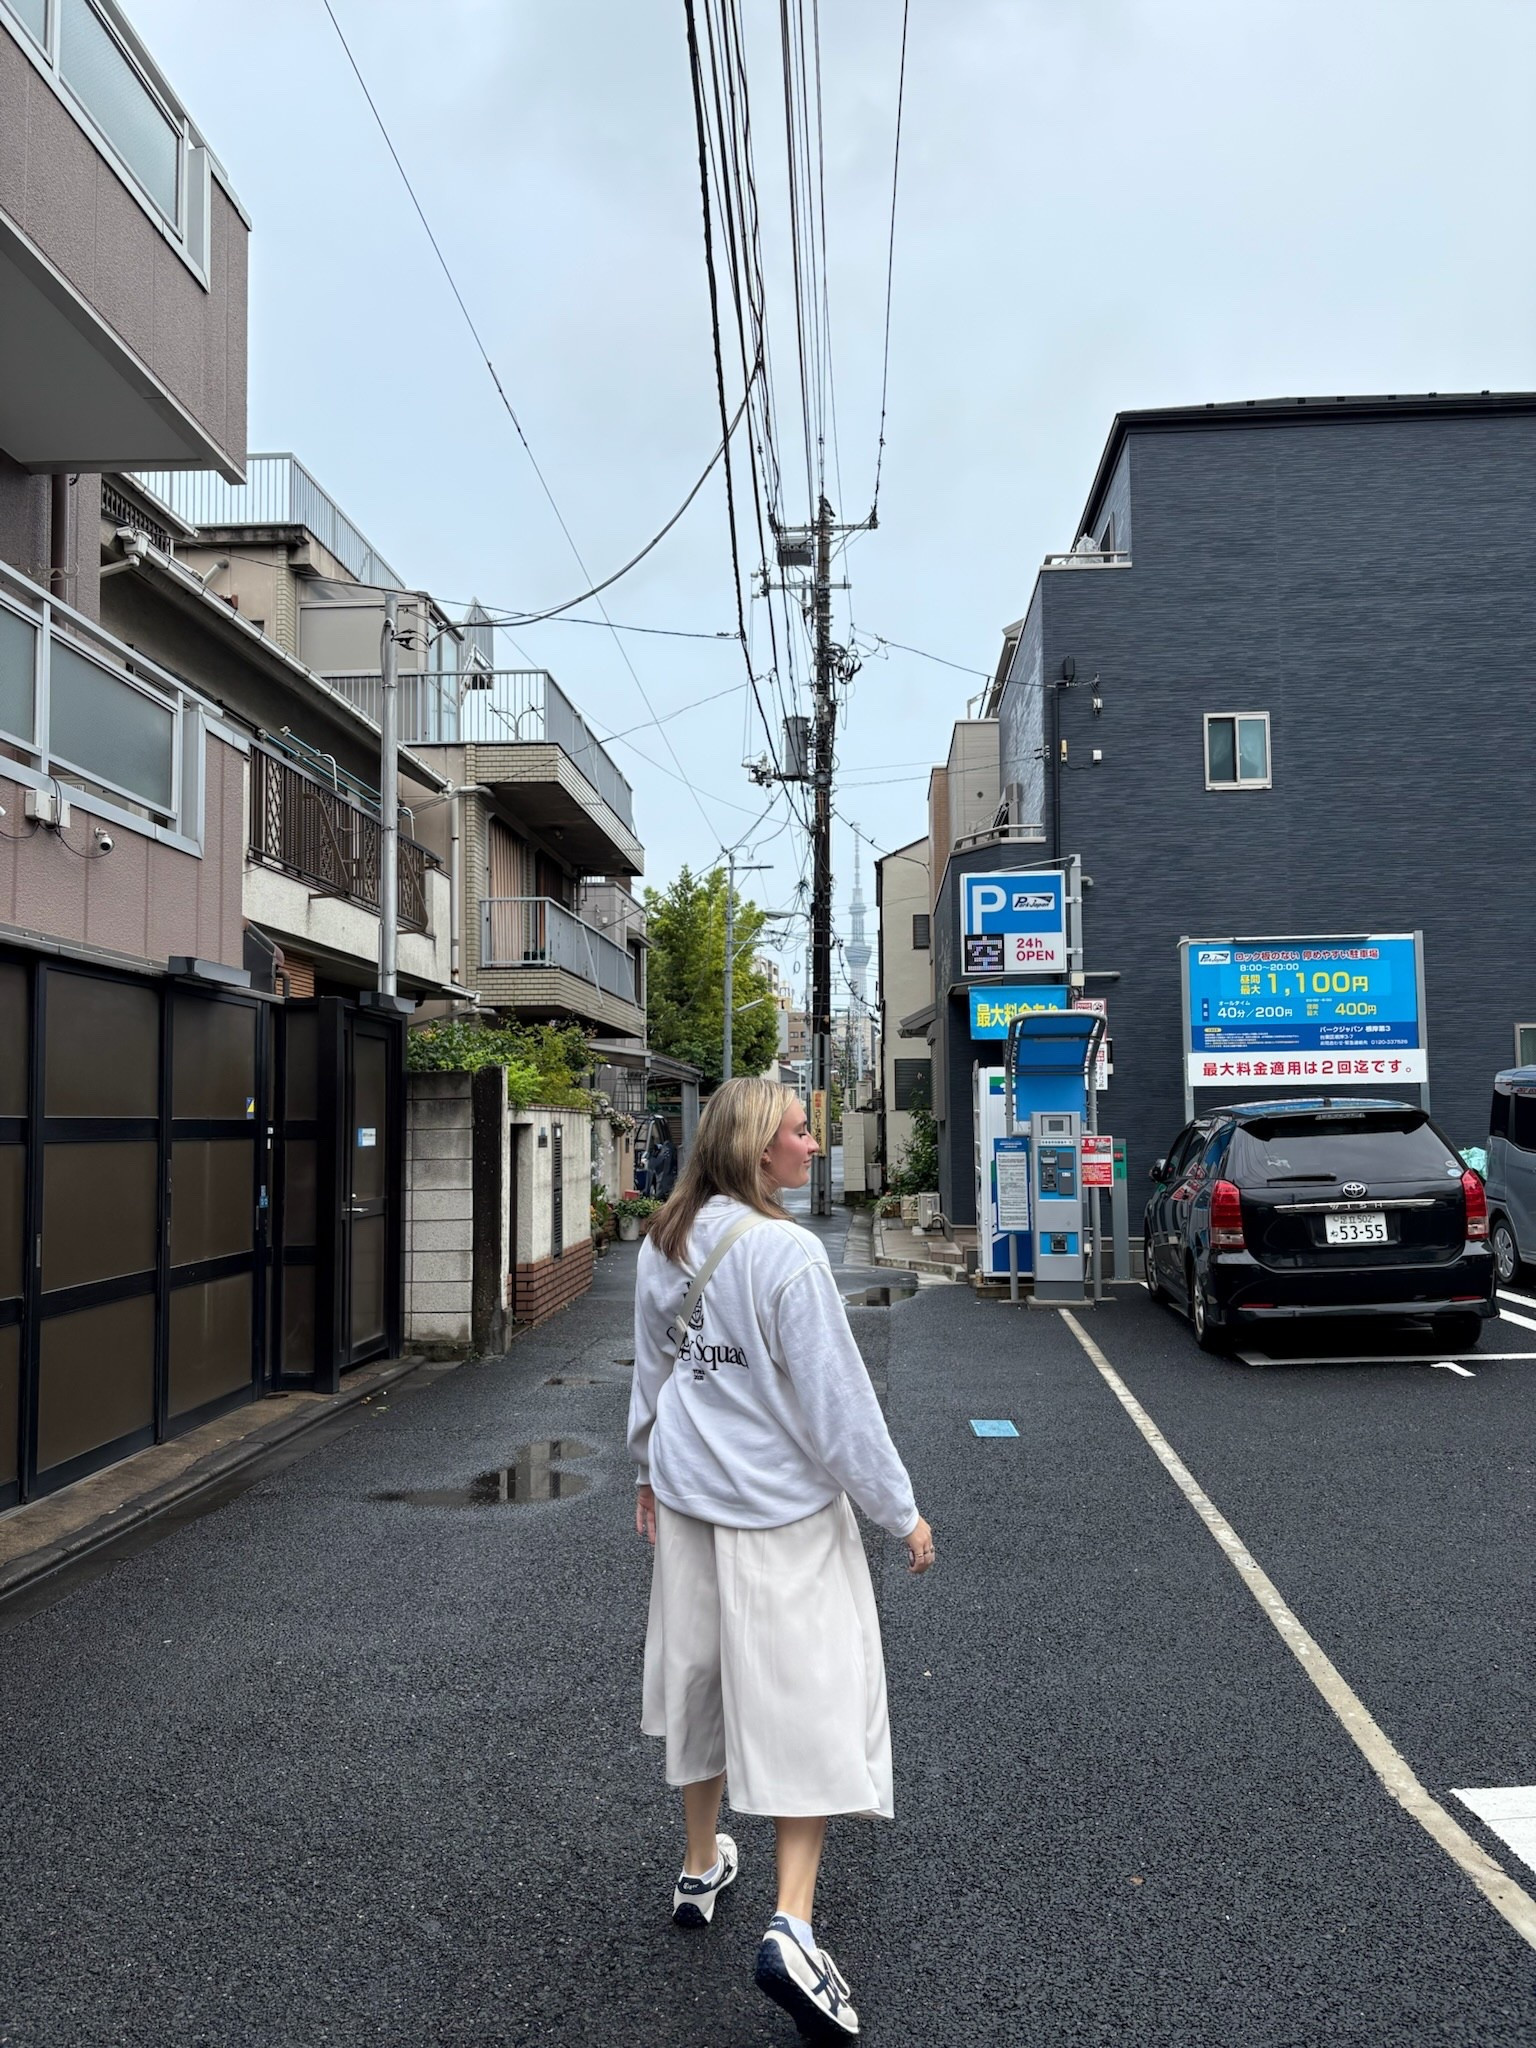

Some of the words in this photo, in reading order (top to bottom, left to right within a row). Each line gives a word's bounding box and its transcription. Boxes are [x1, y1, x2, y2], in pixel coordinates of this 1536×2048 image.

[972, 885, 1007, 935] P
[1016, 938, 1042, 949] 24h
[967, 936, 1003, 971] 空
[1016, 950, 1055, 961] OPEN
[1235, 951, 1299, 962] ロック板のない
[1302, 948, 1379, 960] 停めやすい駐車場
[1240, 985, 1261, 995] 最大
[1267, 970, 1369, 996] 1,100円
[1334, 1002, 1377, 1016] 400円
[1319, 1025, 1364, 1033] パークジャパン
[1202, 1059, 1412, 1077] 最大料金適用は2回迄です。
[1328, 1202, 1383, 1211] WISH
[1357, 1214, 1372, 1223] 502
[1339, 1224, 1384, 1240] 53-55
[693, 1334, 750, 1371] Squad
